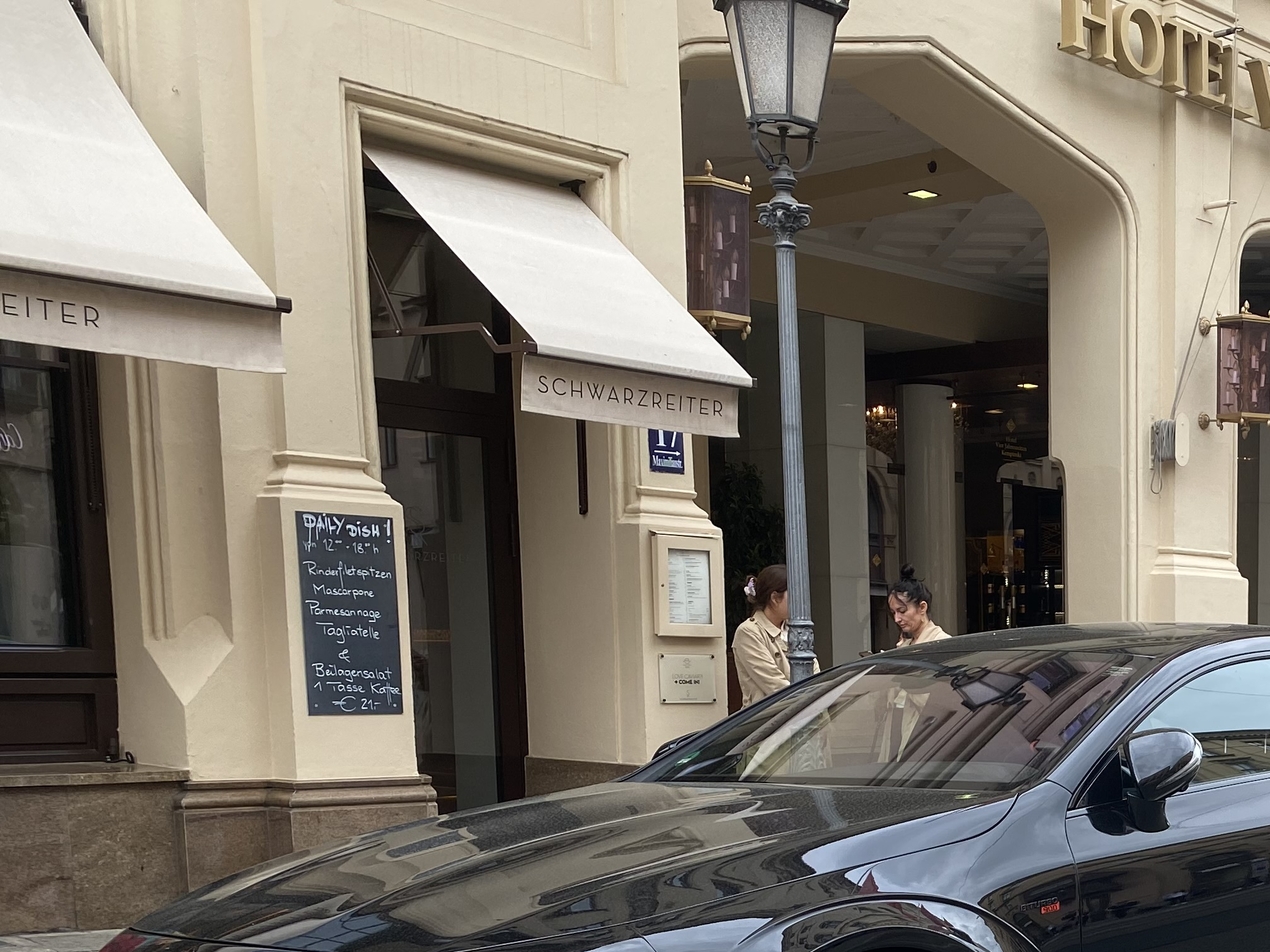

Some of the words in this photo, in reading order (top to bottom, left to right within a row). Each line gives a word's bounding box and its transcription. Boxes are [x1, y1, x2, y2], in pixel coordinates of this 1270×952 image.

[1058, 0, 1260, 121] HOTEL
[537, 375, 724, 417] SCHWARZREITER
[313, 583, 375, 600] Mascarpone
[315, 622, 381, 643] Tagliatelle
[311, 662, 393, 683] Beilagensalat
[313, 681, 323, 692] 1
[326, 681, 366, 693] Tasse
